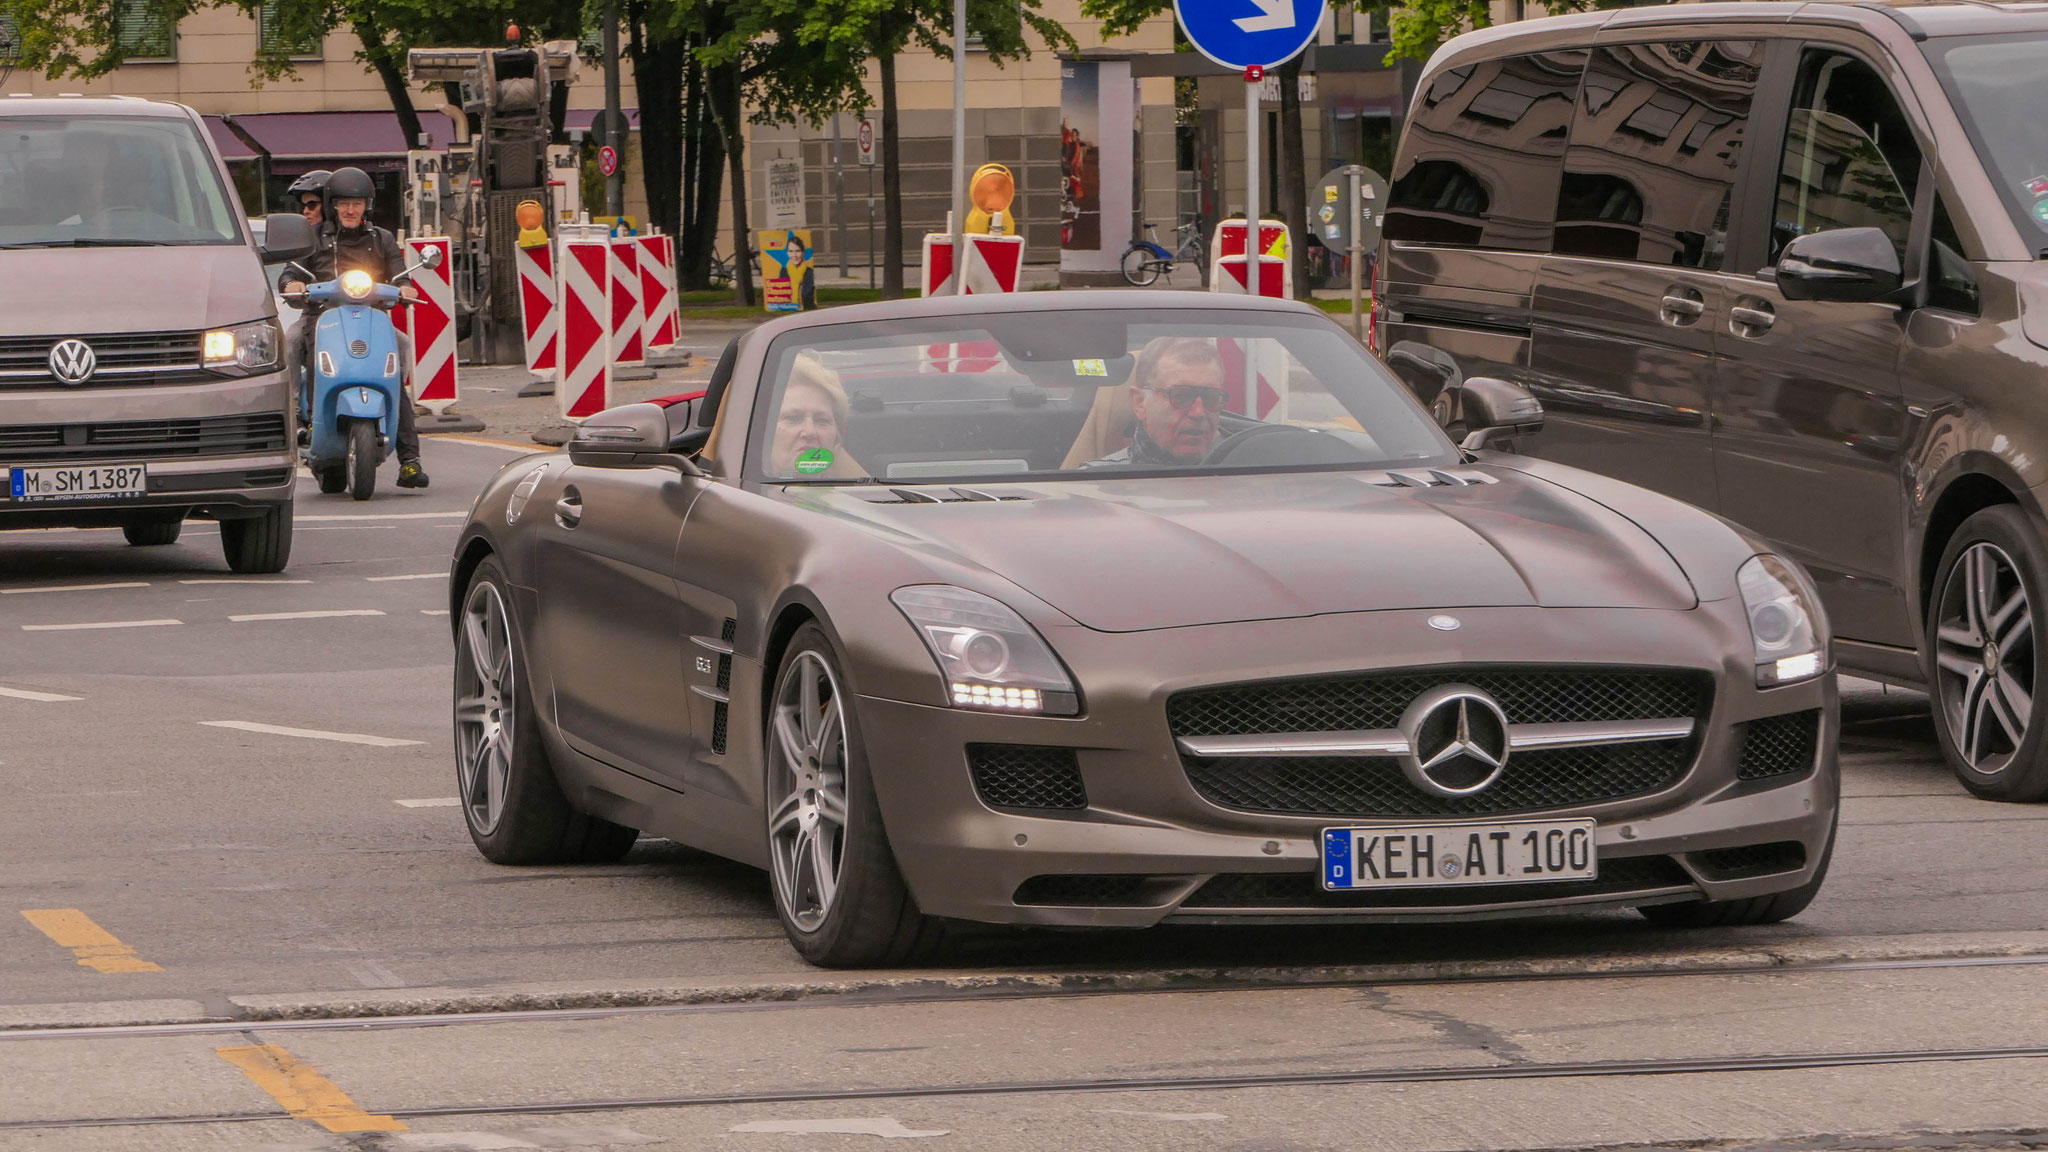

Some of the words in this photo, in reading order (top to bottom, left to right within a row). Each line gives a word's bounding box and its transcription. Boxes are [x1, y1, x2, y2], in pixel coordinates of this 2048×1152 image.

[810, 449, 822, 461] 4
[26, 472, 39, 492] M
[56, 470, 83, 491] SM
[88, 467, 142, 490] 1387
[1357, 834, 1434, 879] KEH
[1464, 831, 1510, 876] AT
[1522, 827, 1589, 874] 100
[1333, 865, 1344, 878] D
